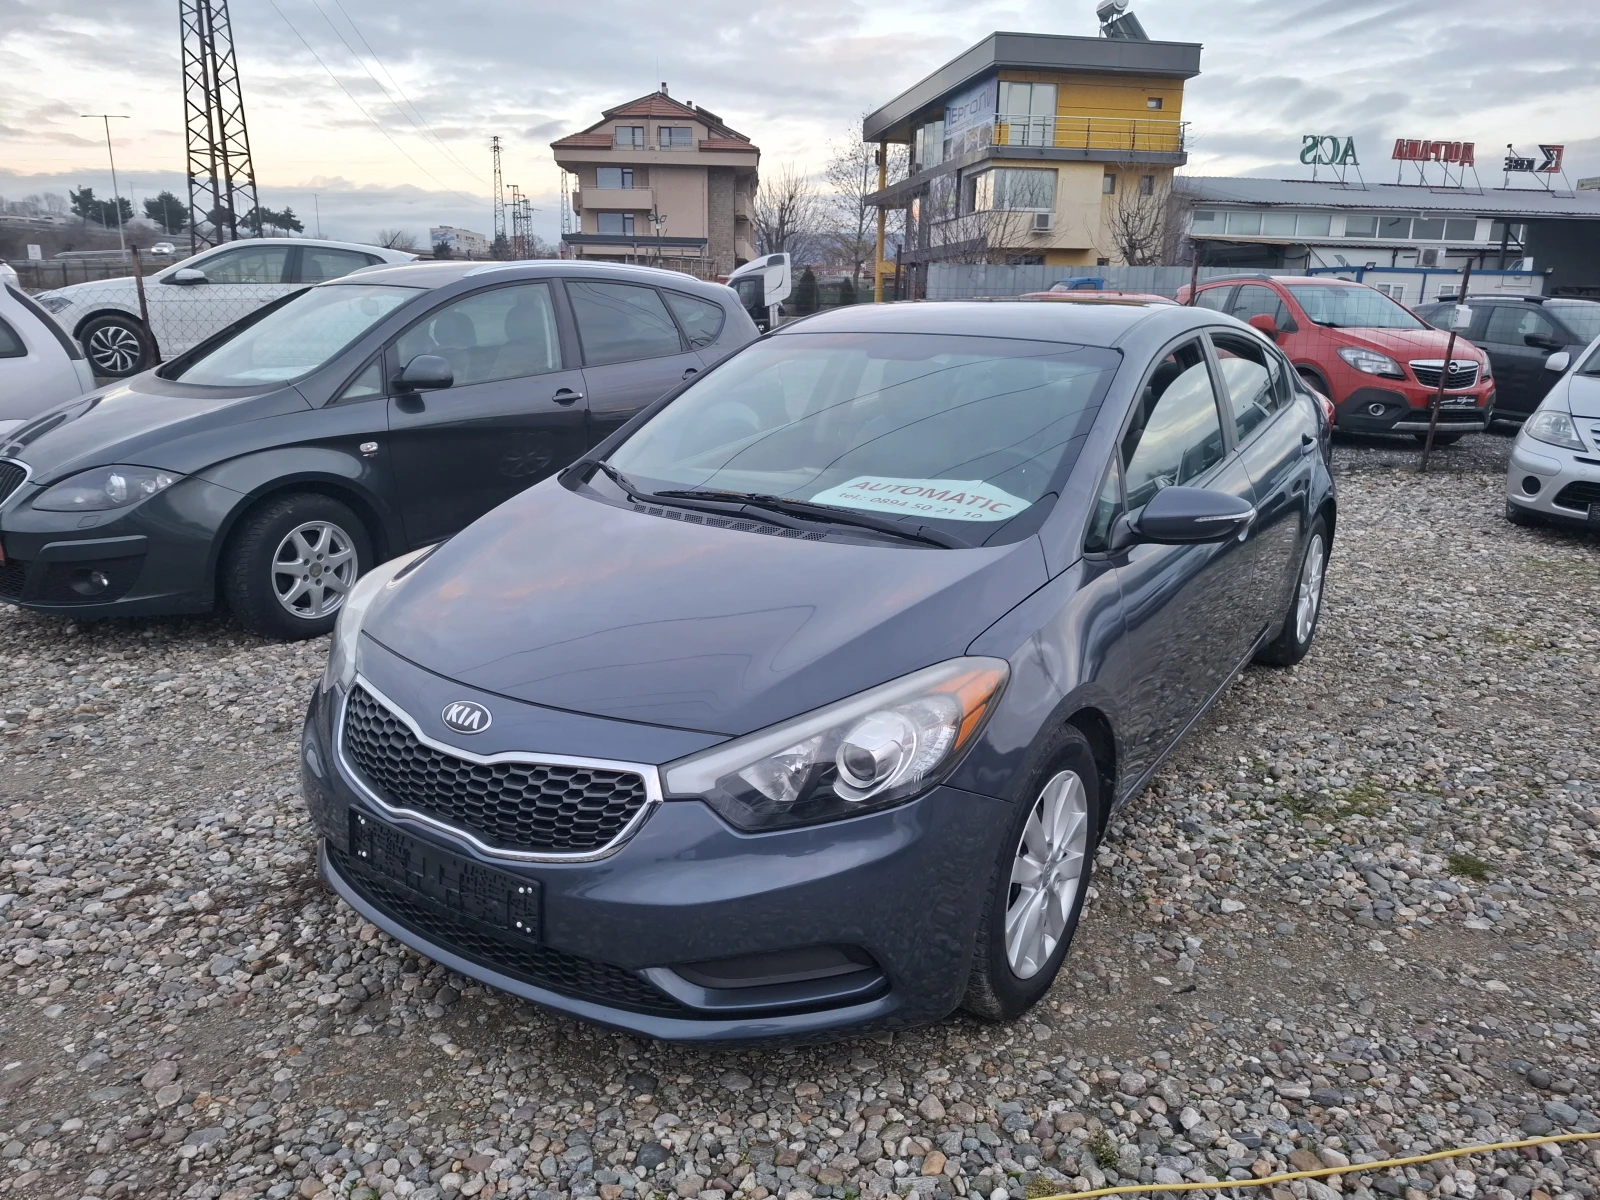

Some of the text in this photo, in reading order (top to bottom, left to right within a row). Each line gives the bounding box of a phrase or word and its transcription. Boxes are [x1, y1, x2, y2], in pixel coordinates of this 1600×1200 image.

[847, 481, 1012, 514] AUTOMATIC
[870, 497, 909, 507] 0894
[911, 503, 933, 511] 50
[963, 511, 983, 519] 10
[445, 703, 482, 730] KIA
